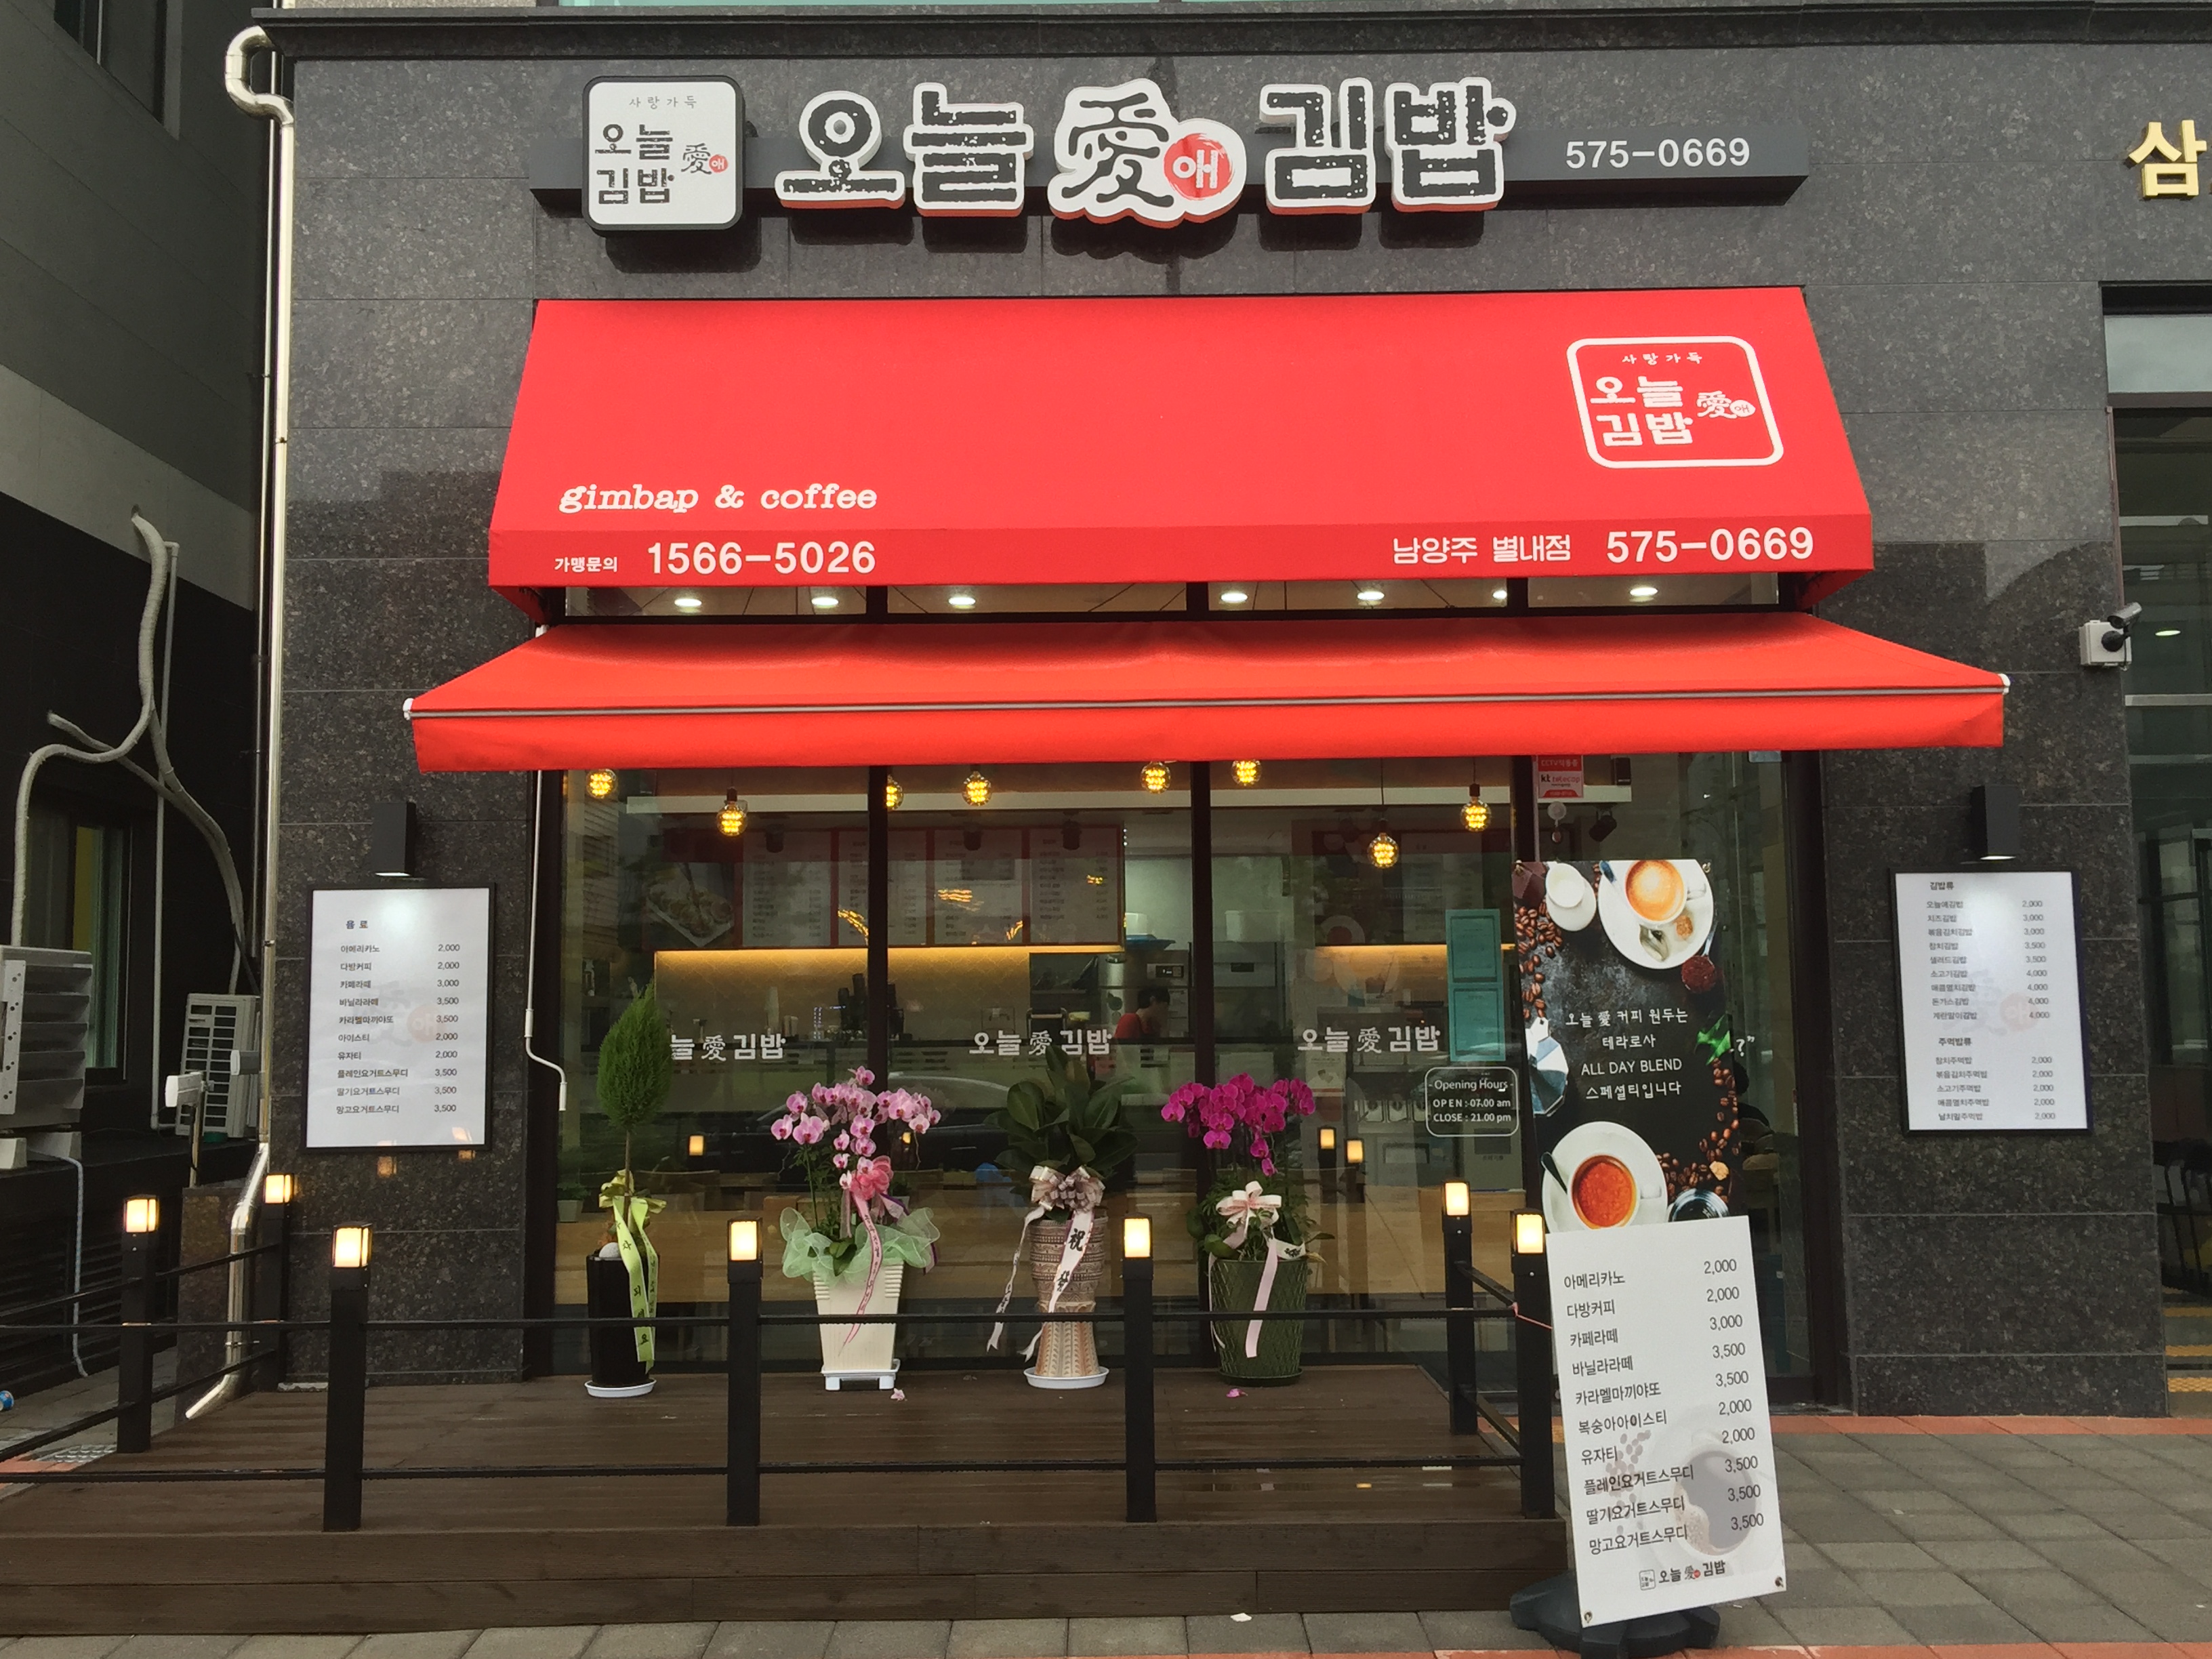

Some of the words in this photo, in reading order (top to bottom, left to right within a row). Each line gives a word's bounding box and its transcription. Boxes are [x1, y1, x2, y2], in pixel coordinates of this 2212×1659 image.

[629, 96, 697, 109] 사랑가득
[595, 124, 673, 159] 오늘
[784, 83, 1026, 206] 오늘
[1060, 91, 1174, 207] 愛
[1264, 82, 1511, 200] 김밥
[1565, 138, 1750, 169] 575-0669
[681, 143, 712, 174] 愛
[2129, 120, 2207, 196] 삼
[596, 168, 674, 204] 김밥
[1591, 375, 1683, 407] 오늘
[1696, 390, 1738, 419] 愛
[1596, 412, 1693, 447] 김밥
[559, 484, 699, 514] gimbap
[714, 485, 744, 509] &
[760, 483, 877, 509] coffee
[554, 556, 618, 573] 가맹문의
[648, 541, 876, 575] 1566-5026
[1393, 536, 1477, 565] 남양주
[1493, 534, 1571, 562] 별내점
[1606, 527, 1814, 562] 575-0669
[436, 1015, 458, 1023] 3,500
[1565, 1012, 1593, 1028] 오늘
[1599, 1010, 1611, 1027] 愛
[1617, 1010, 1642, 1023] 커피
[1649, 1008, 1688, 1025] 원두는
[701, 1035, 726, 1061] 愛
[733, 1033, 786, 1059] 김밥
[969, 1030, 1021, 1056] 오늘
[1060, 1029, 1112, 1054] 김밥
[1298, 1027, 1350, 1052] 오늘
[1357, 1027, 1382, 1053] 愛
[1388, 1025, 1441, 1052] 김밥
[1602, 1034, 1656, 1050] 테라로사
[338, 1052, 361, 1060] 유자티
[1581, 1063, 1605, 1076] ALL
[1610, 1061, 1635, 1074] DAY
[1640, 1059, 1682, 1072] BLEND
[435, 1086, 457, 1094] 3,500
[1435, 1080, 1477, 1091] Opening
[1479, 1080, 1508, 1089] Hours
[1586, 1081, 1681, 1101] 스페셜티입니다
[1433, 1099, 1462, 1107] OPEN
[1433, 1113, 1462, 1122] CLOSE
[1496, 1115, 1511, 1123] pm
[1564, 1271, 1625, 1289] 아메리카노
[1704, 1258, 1737, 1275] 2,000
[1566, 1300, 1615, 1317] 다방커피
[1706, 1287, 1740, 1303] 2,000
[1570, 1328, 1618, 1347] 카페라떼
[1709, 1315, 1743, 1330] 3,000
[1572, 1355, 1633, 1376] 바닐라라떼
[1712, 1343, 1746, 1358] 3,500
[1575, 1382, 1662, 1406] 카라멜마끼야또
[1715, 1370, 1749, 1387] 3,500
[1578, 1410, 1667, 1435] 복숭아아이스티
[1719, 1399, 1752, 1415] 2,000
[1580, 1446, 1618, 1465] 유자티
[1721, 1427, 1755, 1443] 2,000
[1583, 1465, 1694, 1496] 플레인요거트스무디
[1725, 1456, 1759, 1472] 3,500
[1586, 1496, 1685, 1524] 딸기요거트스무디
[1727, 1484, 1761, 1501] 3,500
[1589, 1524, 1688, 1555] 망고요거트스무디
[1731, 1513, 1764, 1530] 3,500
[1659, 1568, 1681, 1583] 오늘
[1702, 1560, 1725, 1576] 김밥
